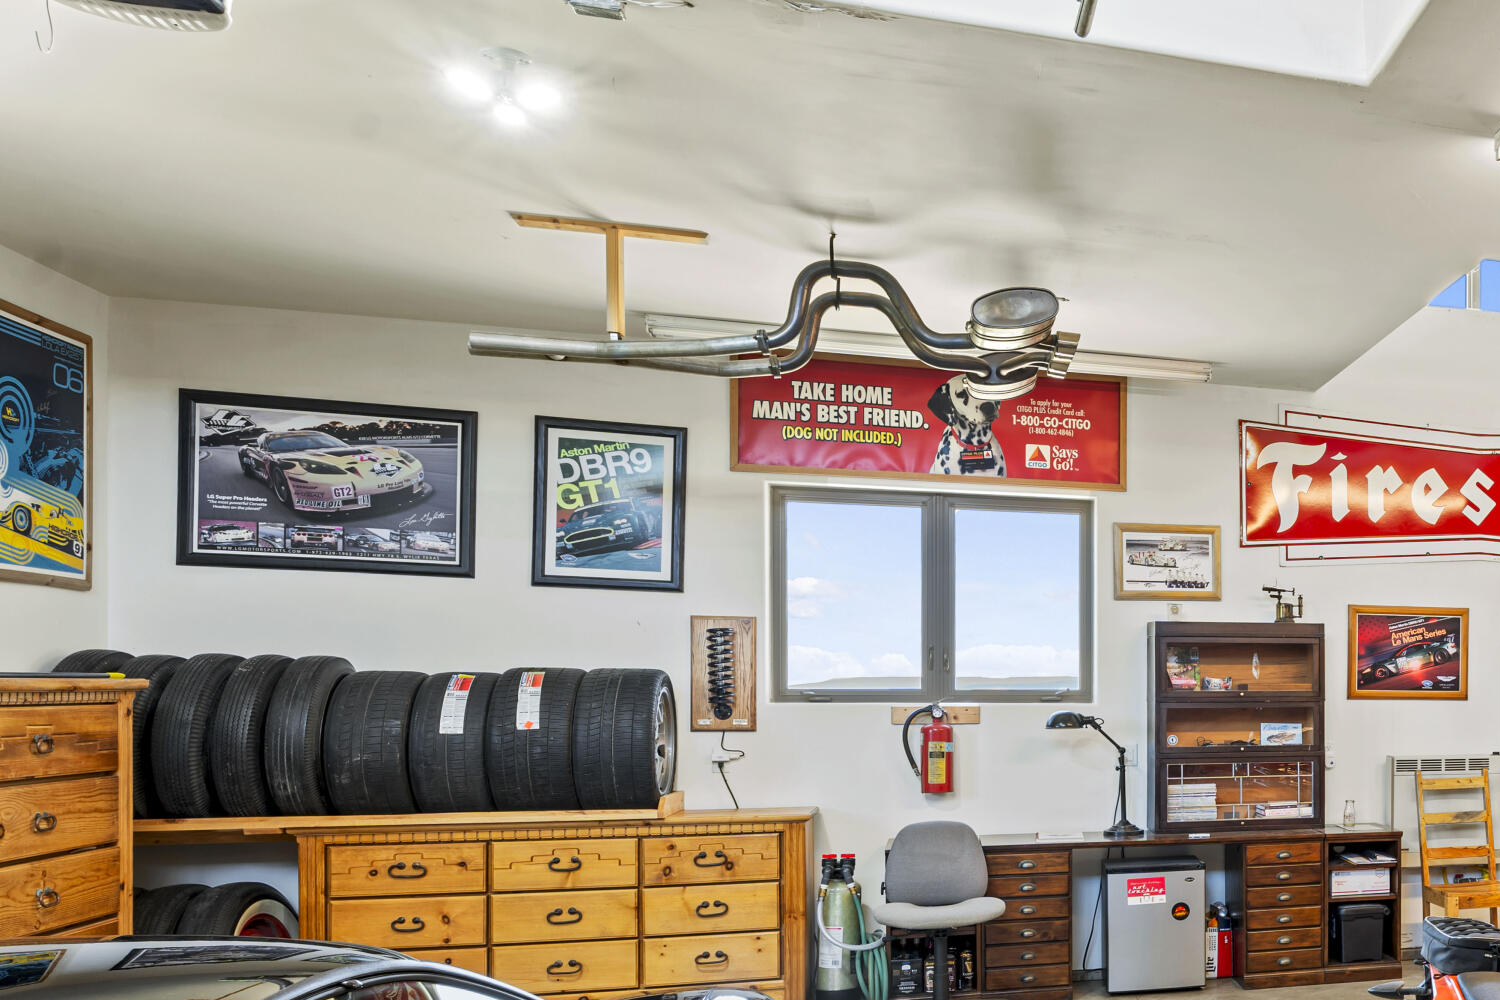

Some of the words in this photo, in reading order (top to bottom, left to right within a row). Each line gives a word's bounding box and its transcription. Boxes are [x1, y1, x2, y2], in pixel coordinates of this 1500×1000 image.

[53, 363, 83, 394] 06
[791, 380, 835, 401] TAKE
[841, 384, 892, 405] HOME
[752, 400, 811, 422] MAN'S
[817, 403, 858, 425] BEST
[863, 408, 930, 430] FRIEND.
[1016, 405, 1032, 413] CITGO
[1012, 414, 1091, 430] 1-800-GO-CITGO
[782, 425, 813, 441] (DOG
[815, 427, 838, 442] NOT
[841, 429, 902, 447] INCLUDED.)
[1028, 427, 1074, 437] (1-800-462-4846)
[560, 446, 592, 458] Aston
[594, 441, 630, 453] Martin
[1052, 445, 1079, 459] Says
[557, 447, 653, 484] DBR9
[1053, 458, 1074, 471] Go!
[333, 487, 352, 498] GT2
[557, 478, 621, 510] GT1
[1392, 627, 1426, 640] American
[1392, 639, 1402, 647] Le
[1403, 634, 1424, 644] Mans
[1424, 628, 1447, 639] Series
